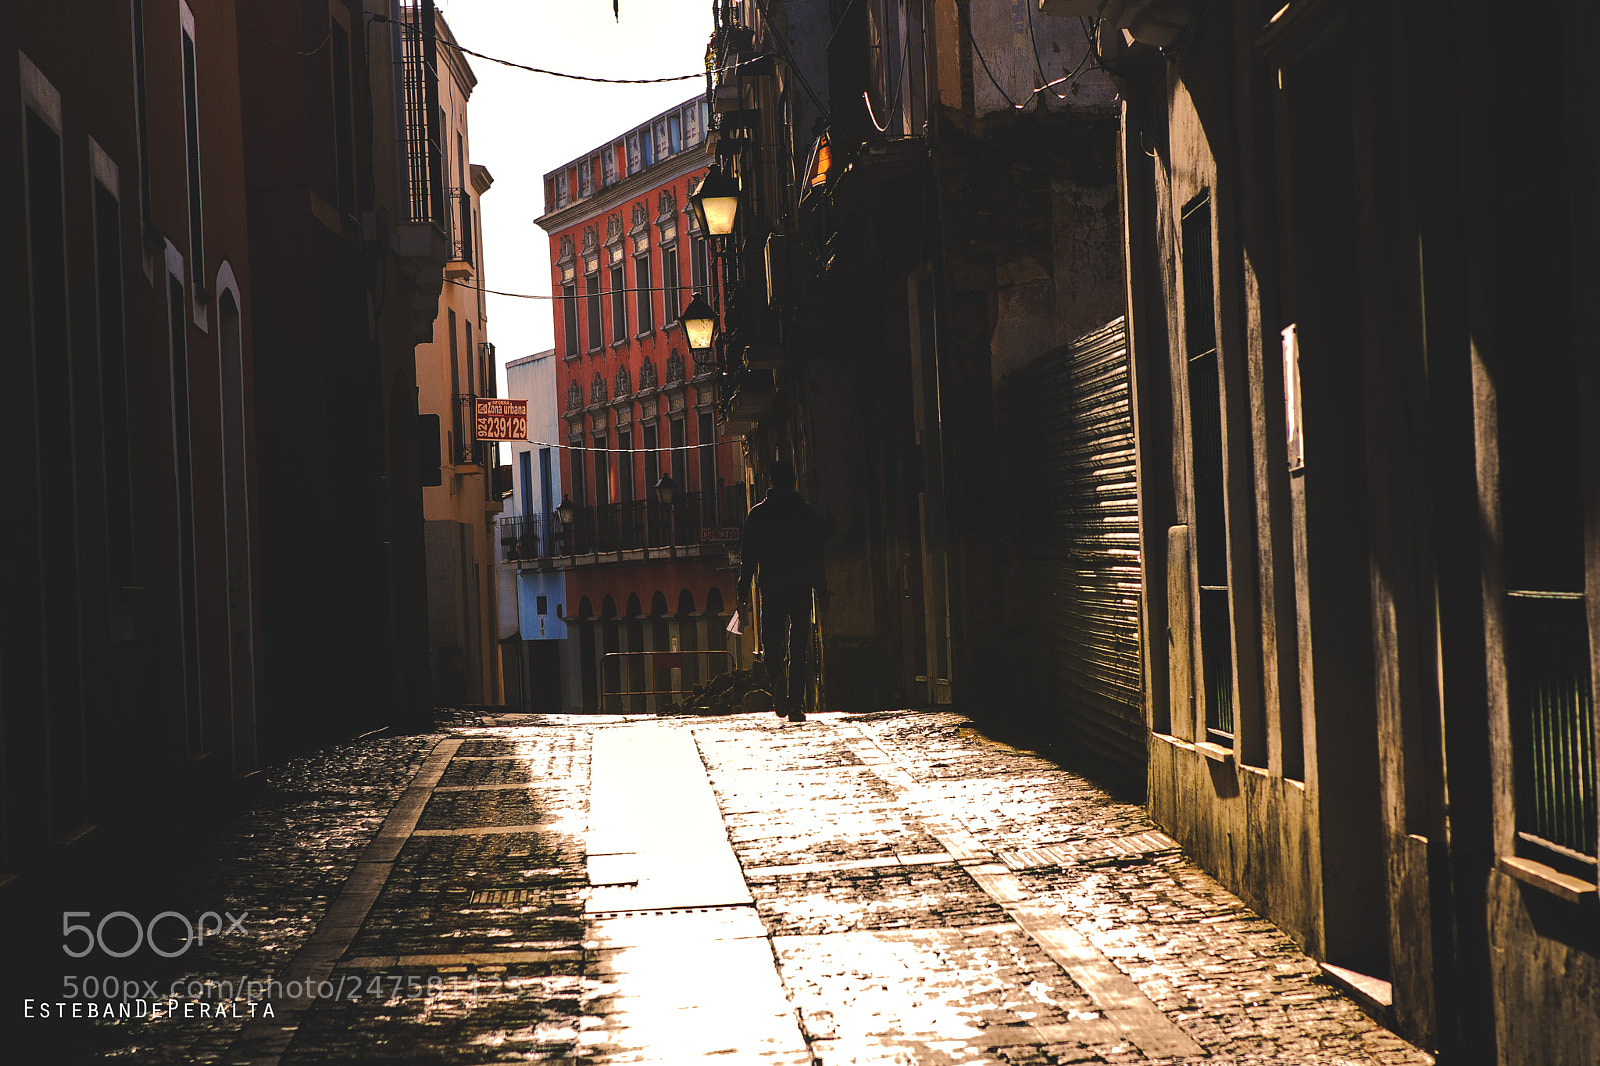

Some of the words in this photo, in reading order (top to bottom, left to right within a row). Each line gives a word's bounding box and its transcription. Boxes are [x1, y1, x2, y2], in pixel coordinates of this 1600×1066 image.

[488, 402, 503, 414] Zona
[504, 402, 526, 415] urbana
[478, 418, 488, 437] 924
[488, 417, 526, 438] 239129
